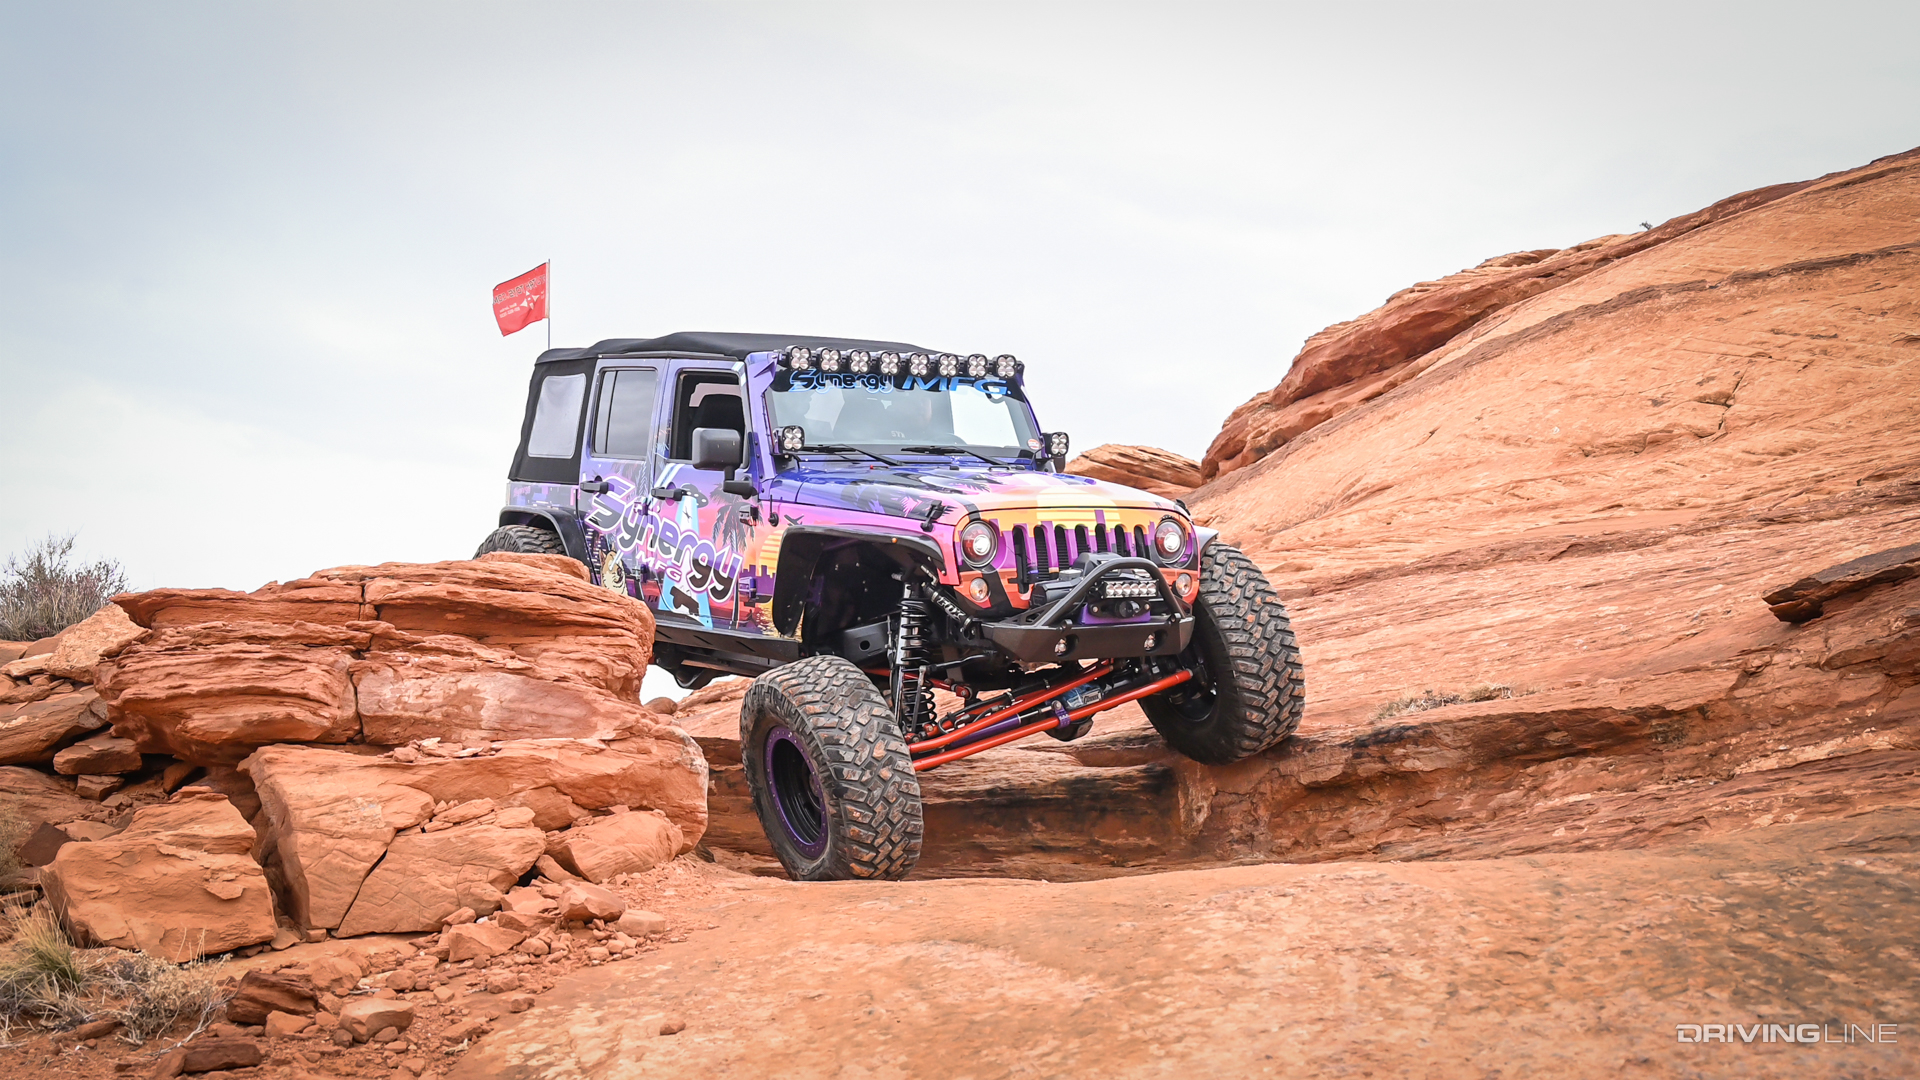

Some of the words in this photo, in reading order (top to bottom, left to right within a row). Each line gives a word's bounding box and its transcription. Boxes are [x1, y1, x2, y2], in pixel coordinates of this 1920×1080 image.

[788, 368, 894, 394] Synergy
[584, 475, 743, 602] Synergy
[635, 550, 682, 582] MFG
[936, 594, 967, 621] FOX
